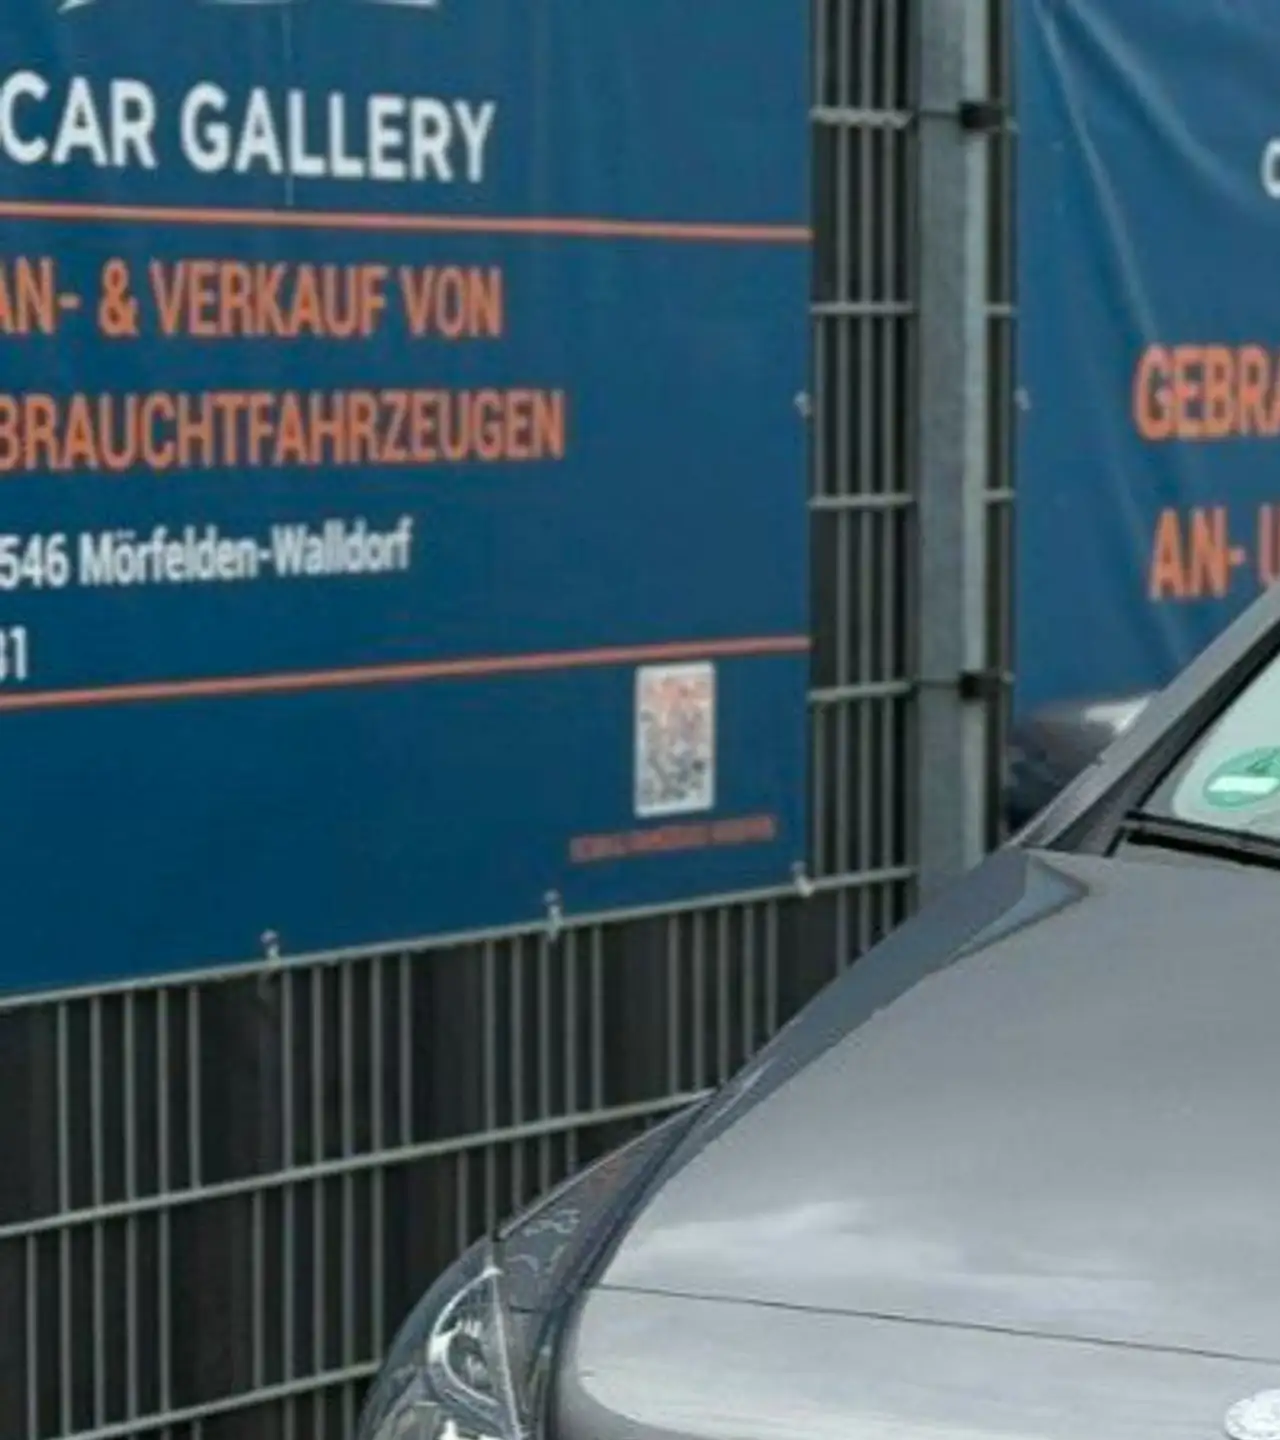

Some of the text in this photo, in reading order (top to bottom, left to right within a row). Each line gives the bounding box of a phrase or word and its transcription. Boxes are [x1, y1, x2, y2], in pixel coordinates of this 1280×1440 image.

[1, 70, 495, 183] CAR GALLERY
[99, 258, 138, 336] &
[150, 257, 388, 338] VERKAUF
[402, 264, 504, 338] VON
[78, 514, 414, 585] Mörfelden-Walldorf
[1149, 505, 1246, 600] AN-
